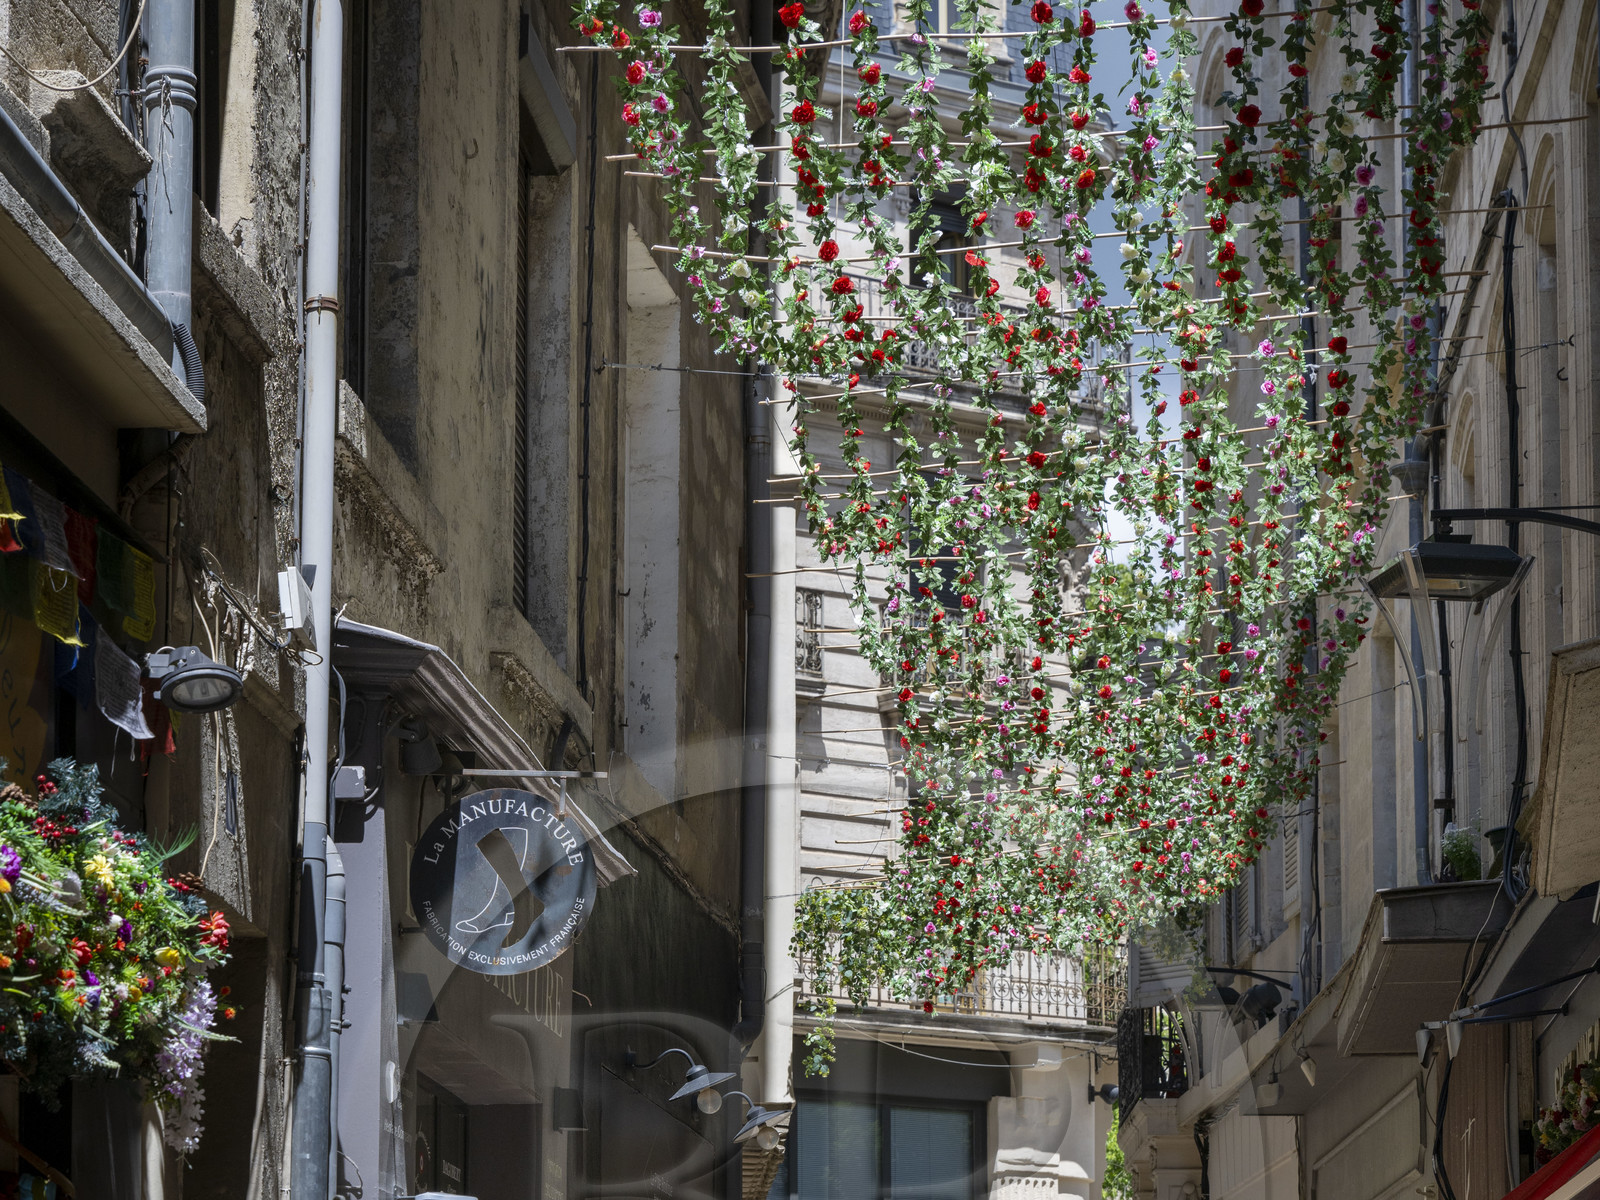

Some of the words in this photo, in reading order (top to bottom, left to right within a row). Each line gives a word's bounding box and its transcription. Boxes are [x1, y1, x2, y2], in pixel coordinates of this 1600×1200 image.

[424, 842, 445, 865] La
[440, 798, 584, 867] MANUFACTURE
[422, 900, 467, 955] FABRICATION
[467, 944, 548, 966] EXCLUSIVEMENT
[550, 896, 586, 947] FRANÇAISE
